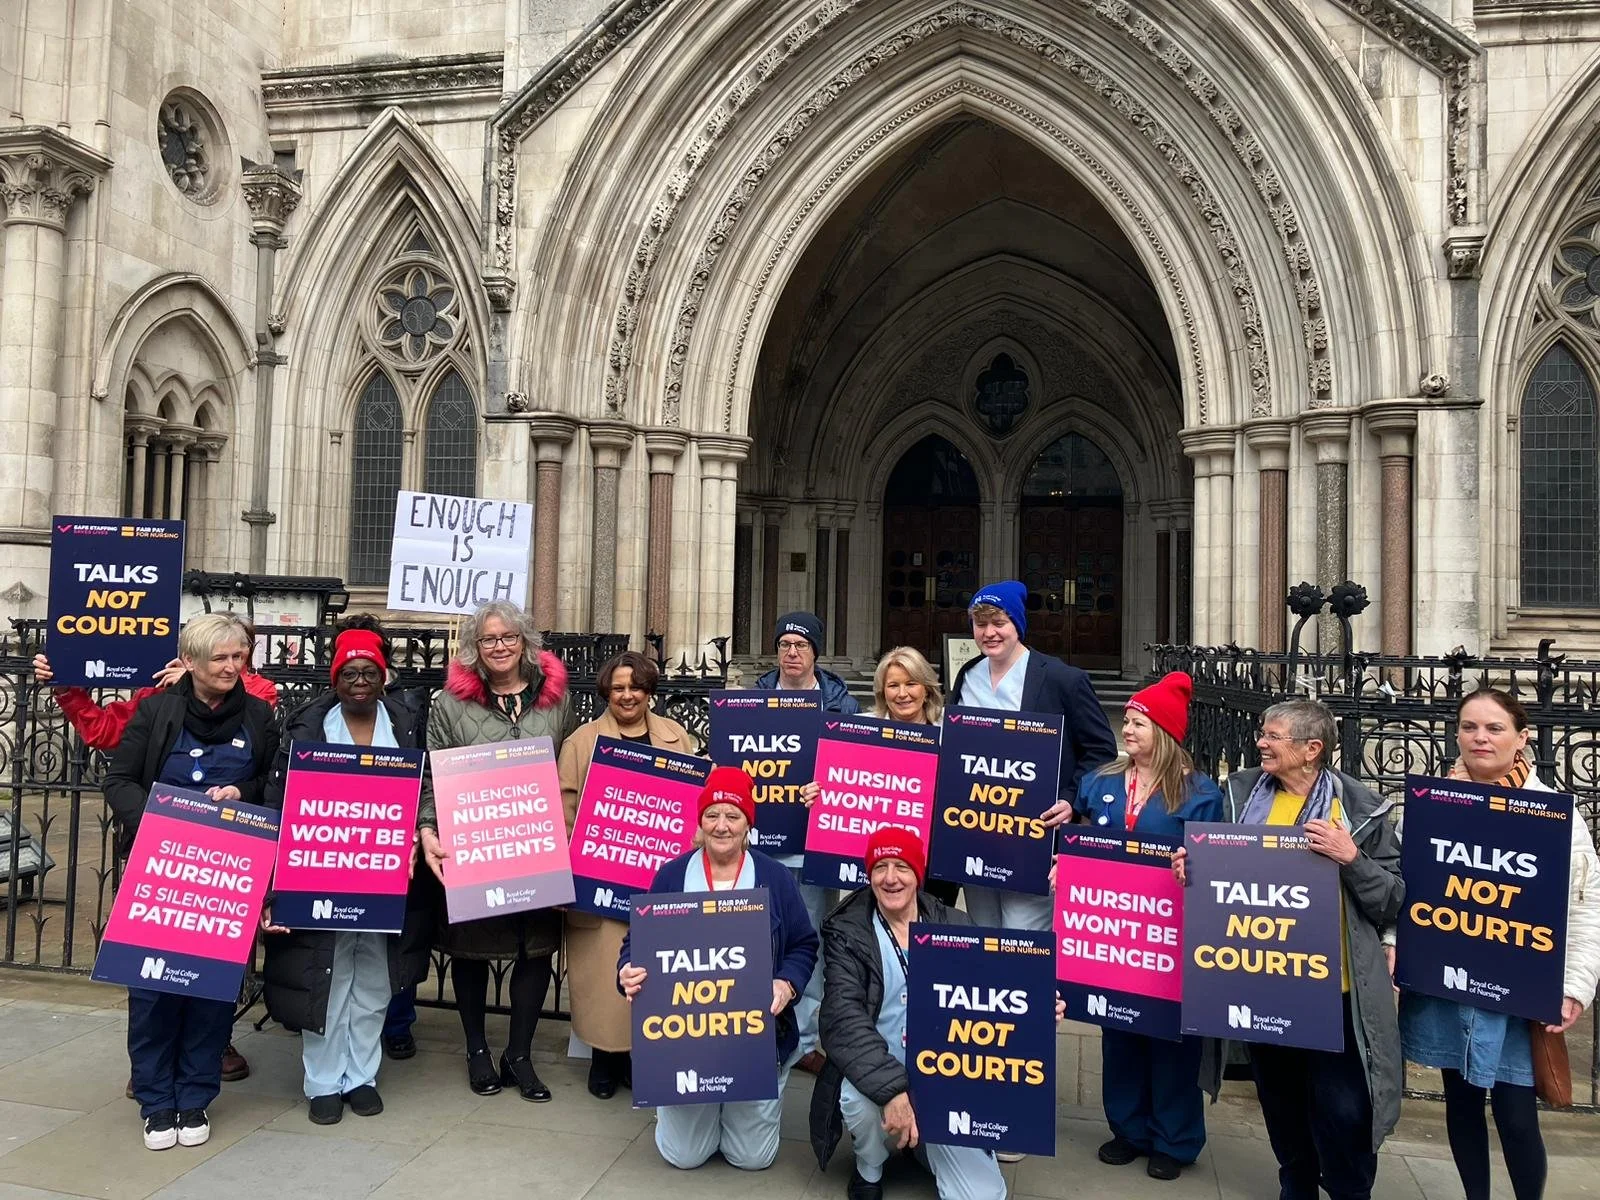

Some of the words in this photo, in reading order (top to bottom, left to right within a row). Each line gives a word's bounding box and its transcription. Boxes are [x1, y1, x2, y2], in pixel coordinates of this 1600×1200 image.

[410, 496, 516, 538] ENOUGH
[452, 535, 474, 562] IS
[74, 564, 158, 584] TALKS
[401, 564, 513, 608] ENOUGH
[87, 590, 146, 609] NOT
[58, 616, 169, 635] COURTS
[86, 660, 105, 678] N
[729, 735, 801, 752] TALKS
[742, 760, 791, 777] NOT
[961, 755, 1036, 781] TALKS
[829, 768, 920, 793] NURSING
[458, 783, 539, 805] SILENCING
[605, 787, 681, 814] SILENCING
[821, 790, 892, 813] WON'T
[897, 800, 924, 818] BE
[970, 784, 1024, 806] NOT
[1450, 792, 1484, 802] STAFFING
[300, 800, 402, 820] NURSING
[454, 798, 547, 824] NURSING
[594, 802, 683, 833] NURSING
[1528, 809, 1566, 820] NURSING
[250, 821, 278, 831] NURSING
[453, 833, 467, 846] IS
[472, 820, 553, 843] SILENCING
[819, 814, 920, 838] SILEN
[944, 808, 1044, 838] COURTS
[292, 825, 371, 843] WON'T
[376, 829, 405, 846] BE
[586, 824, 600, 837] IS
[603, 828, 680, 855] SILENCING
[160, 840, 251, 871] SILENCING
[289, 850, 400, 870] SILENCED
[456, 837, 555, 865] PATIENTS
[583, 841, 673, 871] PATIENT
[1431, 839, 1537, 877] TALKS
[146, 858, 252, 893] NURSING
[839, 863, 857, 882] N
[966, 857, 983, 876] N
[984, 866, 997, 875] Royal
[997, 868, 1013, 876] College
[989, 872, 1006, 882] Nursing
[134, 883, 152, 898] IS
[156, 888, 248, 917] SILENCING
[486, 887, 505, 907] N
[594, 888, 613, 907] N
[1070, 886, 1172, 916] NURSING
[1211, 881, 1310, 908] TALKS
[1446, 876, 1520, 908] NOT
[129, 903, 242, 938] PATIENTS
[312, 900, 332, 919] N
[334, 907, 347, 916] Royal
[1063, 911, 1141, 939] WON'T
[1147, 925, 1177, 946] BE
[1227, 915, 1296, 941] NOT
[1411, 903, 1552, 951] COURTS
[657, 947, 746, 972] TALKS
[1063, 938, 1174, 972] SILENCED
[1195, 946, 1328, 978] COURTS
[141, 958, 165, 979] N
[165, 968, 180, 978] Royal
[180, 970, 199, 980] College
[1444, 966, 1467, 991] N
[169, 976, 190, 986] Nursing
[673, 980, 734, 1004] NOT
[1470, 979, 1487, 991] Royal
[1487, 983, 1510, 995] College
[934, 984, 1028, 1014] TALKS
[1088, 995, 1107, 1016] N
[1477, 988, 1501, 1001] Nursing
[1108, 1005, 1122, 1016] Royal
[1122, 1007, 1140, 1018] College
[1114, 1013, 1133, 1023] Nursing
[1229, 1006, 1251, 1028] N
[1254, 1015, 1270, 1027] Royal
[1270, 1017, 1291, 1027] College
[644, 1011, 763, 1039] COURTS
[948, 1020, 1014, 1046] NOT
[1261, 1023, 1283, 1034] Nursing
[917, 1051, 1043, 1084] COURTS
[677, 1071, 698, 1094] N
[700, 1077, 714, 1088] Royal
[714, 1077, 733, 1085] College
[949, 1112, 970, 1134] N
[973, 1121, 988, 1132] Royal
[988, 1123, 1008, 1133] College
[979, 1129, 1000, 1140] Nursing
